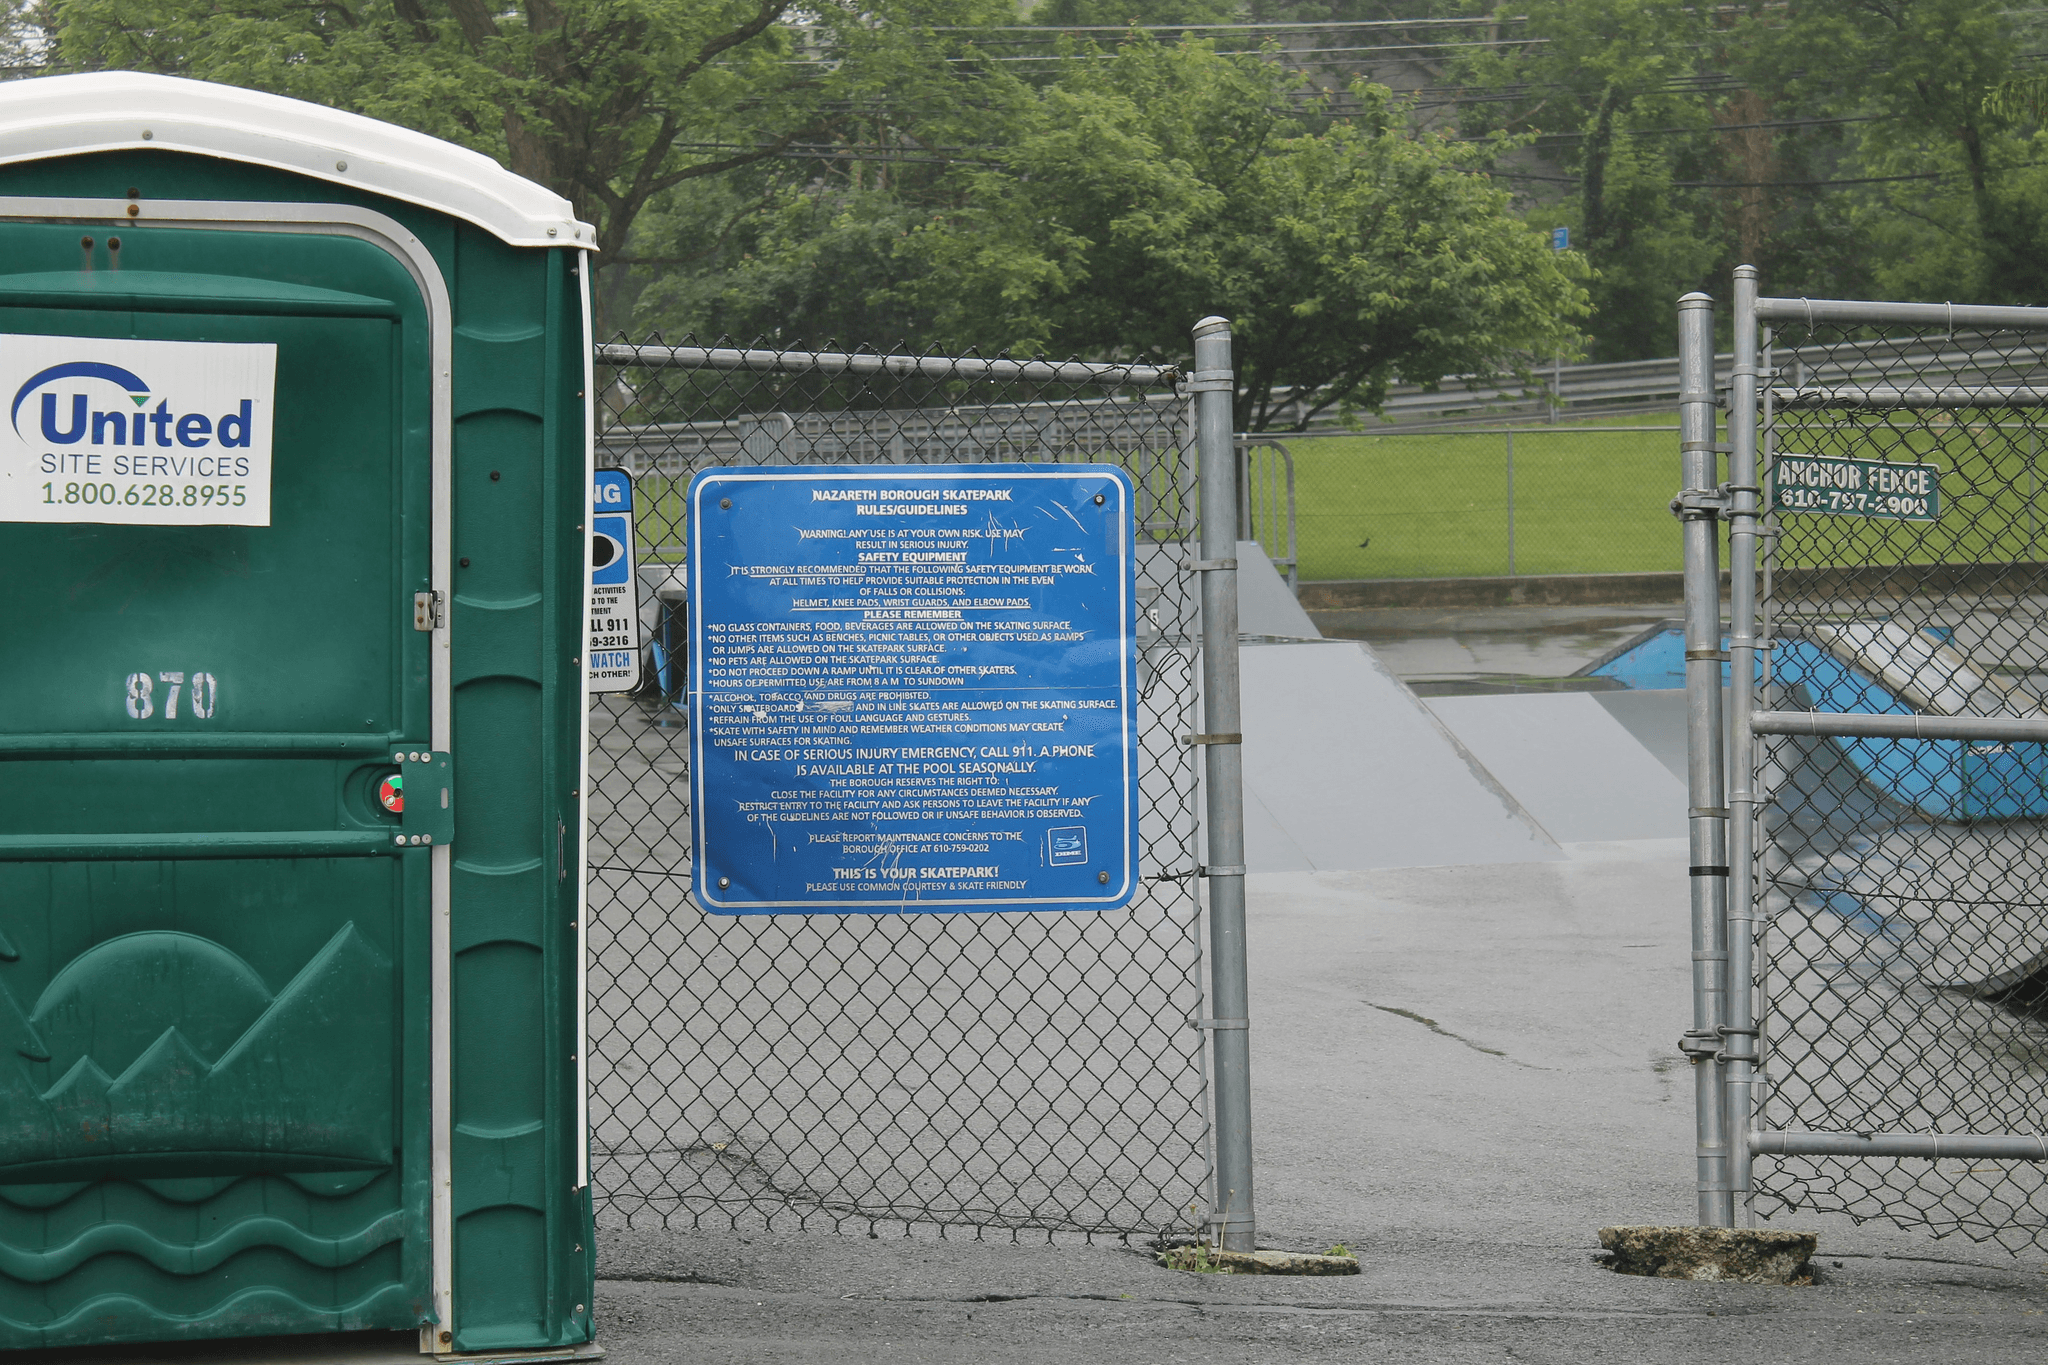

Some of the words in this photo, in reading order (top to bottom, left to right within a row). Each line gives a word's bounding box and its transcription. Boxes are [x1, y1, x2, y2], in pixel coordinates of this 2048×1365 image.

[41, 393, 252, 448] United
[40, 453, 102, 474] SITE
[113, 455, 249, 477] SERVICES
[1777, 460, 1862, 489] ANCHOR
[1868, 466, 1930, 495] FENCE
[42, 482, 246, 506] 1.800.628.8955
[812, 489, 877, 501] NAZARETH
[879, 489, 940, 501] BOROUGH
[942, 489, 1013, 501] SKATEPARK
[1780, 488, 1928, 516] 610-797-2900
[857, 504, 968, 515] RULES/GUIDELINES
[847, 529, 868, 538] ANY
[887, 529, 895, 538] IS
[897, 529, 908, 538] AT
[910, 529, 936, 538] YOUR
[937, 529, 960, 538] OWN
[962, 529, 983, 538] RISK.
[855, 540, 886, 549] RESULT
[888, 540, 898, 549] IN
[899, 540, 935, 549] SERIOUS
[937, 540, 970, 549] INJURY.
[858, 552, 899, 562] SAFETY
[902, 552, 967, 562] EQUIPMENT
[769, 577, 780, 586] AT
[782, 577, 798, 586] ALL
[800, 577, 826, 586] TIMES
[829, 577, 840, 585] TO
[842, 577, 863, 585] HELP
[865, 577, 902, 585] PROVIDE
[904, 577, 944, 585] SUITABLE
[946, 576, 1000, 585] PROTECTION
[1001, 576, 1011, 585] IN
[1013, 576, 1029, 585] THE
[1031, 576, 1055, 585] EVEN
[859, 587, 871, 596] OF
[873, 587, 898, 596] FALLS
[899, 587, 912, 596] OR
[914, 587, 966, 596] COLLISIONS:
[793, 599, 829, 607] HELMET,
[831, 599, 854, 607] KNEE
[856, 598, 880, 607] PADS,
[883, 598, 909, 607] WRIST
[911, 598, 949, 607] GUARDS,
[952, 598, 972, 607] AND
[973, 598, 1005, 607] ELBOW
[1006, 598, 1032, 607] PADS.
[864, 610, 901, 619] PLEASE
[903, 610, 962, 619] REMEMBER
[607, 618, 628, 632] 911
[727, 623, 754, 632] GLASS
[756, 623, 812, 632] CONTAINERS,
[815, 623, 842, 631] FOOD,
[844, 622, 894, 631] BEVERAGES
[896, 622, 913, 631] ARE
[915, 622, 958, 631] ALLOWED
[959, 622, 974, 630] ON
[976, 622, 991, 630] THE
[993, 622, 1031, 630] SKATING
[1032, 621, 1073, 630] SURFACE.
[712, 645, 725, 654] OR
[757, 645, 774, 654] ARE
[776, 645, 820, 654] ALLOWED
[821, 645, 836, 654] ON
[838, 645, 854, 653] THE
[856, 644, 905, 653] SKATEPARK
[907, 644, 947, 653] SURFACE.
[590, 652, 630, 668] WATCH
[728, 657, 748, 666] PETS
[750, 656, 767, 665] ARE
[769, 656, 812, 665] ALLOWED
[814, 656, 828, 665] ON
[831, 656, 846, 665] THE
[849, 656, 897, 664] SKATEPARK
[899, 655, 940, 664] SURFACE.
[126, 672, 217, 719] 870
[751, 715, 777, 724] FROM
[780, 715, 795, 724] THE
[798, 715, 814, 723] USE
[816, 714, 827, 723] OF
[830, 714, 852, 723] FOUL
[855, 714, 903, 723] LANGUAGE
[905, 714, 925, 722] AND
[926, 713, 972, 722] GESTURES.
[714, 738, 747, 747] UNSAFE
[749, 737, 791, 746] SURFACES
[793, 737, 811, 746] FOR
[813, 737, 853, 746] SKATING.
[734, 750, 747, 761] IN
[750, 749, 780, 761] CASE
[784, 749, 799, 760] OF
[803, 748, 852, 760] SERIOUS
[856, 748, 897, 760] INJURY
[901, 746, 976, 759] EMERGENCY,
[980, 746, 1009, 758] CALL
[1012, 746, 1036, 758] 911.
[1052, 745, 1095, 758] PHONE
[796, 764, 807, 776] IS
[810, 763, 874, 776] AVAILABLE
[878, 763, 893, 775] AT
[897, 763, 919, 774] THE
[923, 762, 955, 774] POOL
[958, 761, 1037, 774] SEASONALLY.
[830, 778, 846, 787] THE
[849, 778, 894, 787] BOROUGH
[895, 777, 936, 787] RESERVES
[939, 777, 954, 786] THE
[957, 777, 982, 786] RIGHT
[986, 777, 1000, 786] TO:
[771, 790, 797, 799] CLOSE
[800, 790, 816, 798] THE
[819, 789, 855, 798] FACILITY
[857, 789, 875, 798] FOR
[877, 789, 896, 798] ANY
[898, 788, 968, 797] CIRCUMSTANCES
[970, 787, 1007, 797] DEEMED
[1008, 787, 1059, 796] NECESSARY.
[843, 844, 889, 854] BOROUGH
[920, 844, 931, 853] AT
[933, 843, 990, 853] 610-759-0202
[834, 868, 862, 879] THIS
[864, 867, 876, 879] IS
[880, 867, 917, 879] YOUR
[920, 866, 1000, 878] SKATEPARK!
[807, 883, 837, 892] PLEASE
[839, 882, 855, 891] USE
[857, 882, 900, 891] COMMON
[902, 882, 946, 891] COURTESY
[949, 881, 955, 890] &
[957, 881, 983, 890] SKATE
[986, 881, 1027, 890] FRIENDLY
